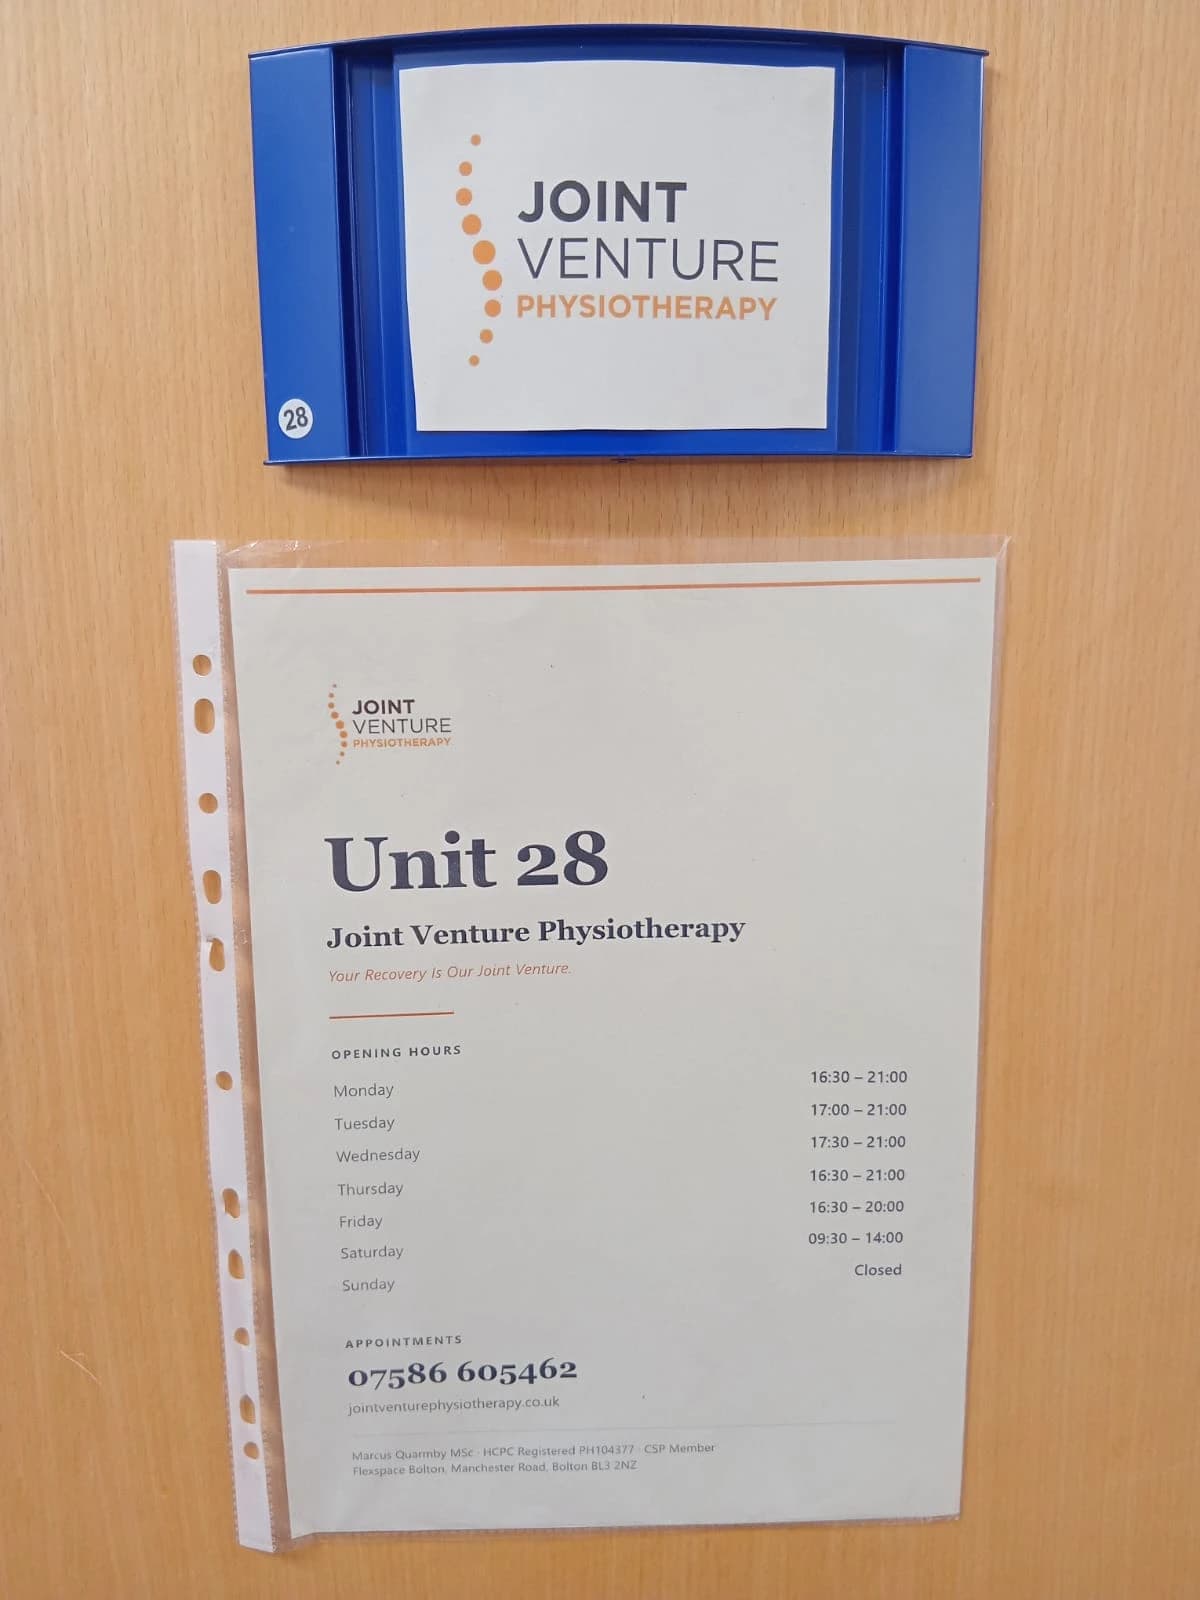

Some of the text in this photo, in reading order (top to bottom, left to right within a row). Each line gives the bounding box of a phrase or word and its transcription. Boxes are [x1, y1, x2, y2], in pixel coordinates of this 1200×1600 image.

[518, 180, 687, 223] JOINT
[517, 238, 778, 282] VENTURE
[518, 295, 777, 320] PHYSIOTHERAPY
[283, 405, 309, 431] 28
[352, 699, 415, 714] JOINT
[353, 718, 451, 734] VENTURE
[353, 736, 451, 748] PHYSIOTHERAPY
[324, 831, 608, 892] Unit 28
[327, 917, 746, 948] Joint Venture Physiotherapy
[330, 963, 571, 983] Your Recovery Is Our Joint Venture.
[332, 1045, 460, 1060] OPENING HOURS
[812, 1070, 849, 1084] 16:30
[868, 1070, 907, 1084] 21:00
[334, 1083, 393, 1098] Monday
[812, 1103, 849, 1116] 17:00
[868, 1103, 906, 1116] 21:00
[335, 1117, 394, 1132] Tuesday
[812, 1135, 848, 1149] 17:30
[867, 1135, 905, 1149] 21:00
[336, 1148, 420, 1162] Wednesday
[811, 1169, 848, 1182] 16:30
[866, 1168, 904, 1182] 21:00
[338, 1182, 403, 1197] Thursday
[810, 1200, 847, 1214] 16:30
[866, 1200, 904, 1213] 20:00
[340, 1216, 382, 1229] Friday
[809, 1232, 847, 1245] 09:30
[866, 1231, 903, 1244] 14:00
[341, 1245, 403, 1259] Saturday
[855, 1263, 901, 1276] Closed
[343, 1278, 395, 1293] Sunday
[345, 1335, 461, 1349] APPOINTMENTS
[349, 1358, 577, 1390] 07586 605462
[348, 1397, 559, 1416] jointventurephysiotherapy.co.uk
[353, 1442, 714, 1461] Marcus Quarmby MSc HCPC Registered PH104377 CSP Member
[354, 1466, 405, 1478] Flexspace
[452, 1463, 514, 1473] Manchester
[519, 1462, 548, 1473] Road,
[552, 1461, 587, 1472] Bolton
[592, 1460, 610, 1471] BL3
[614, 1459, 637, 1471] 2NZ
